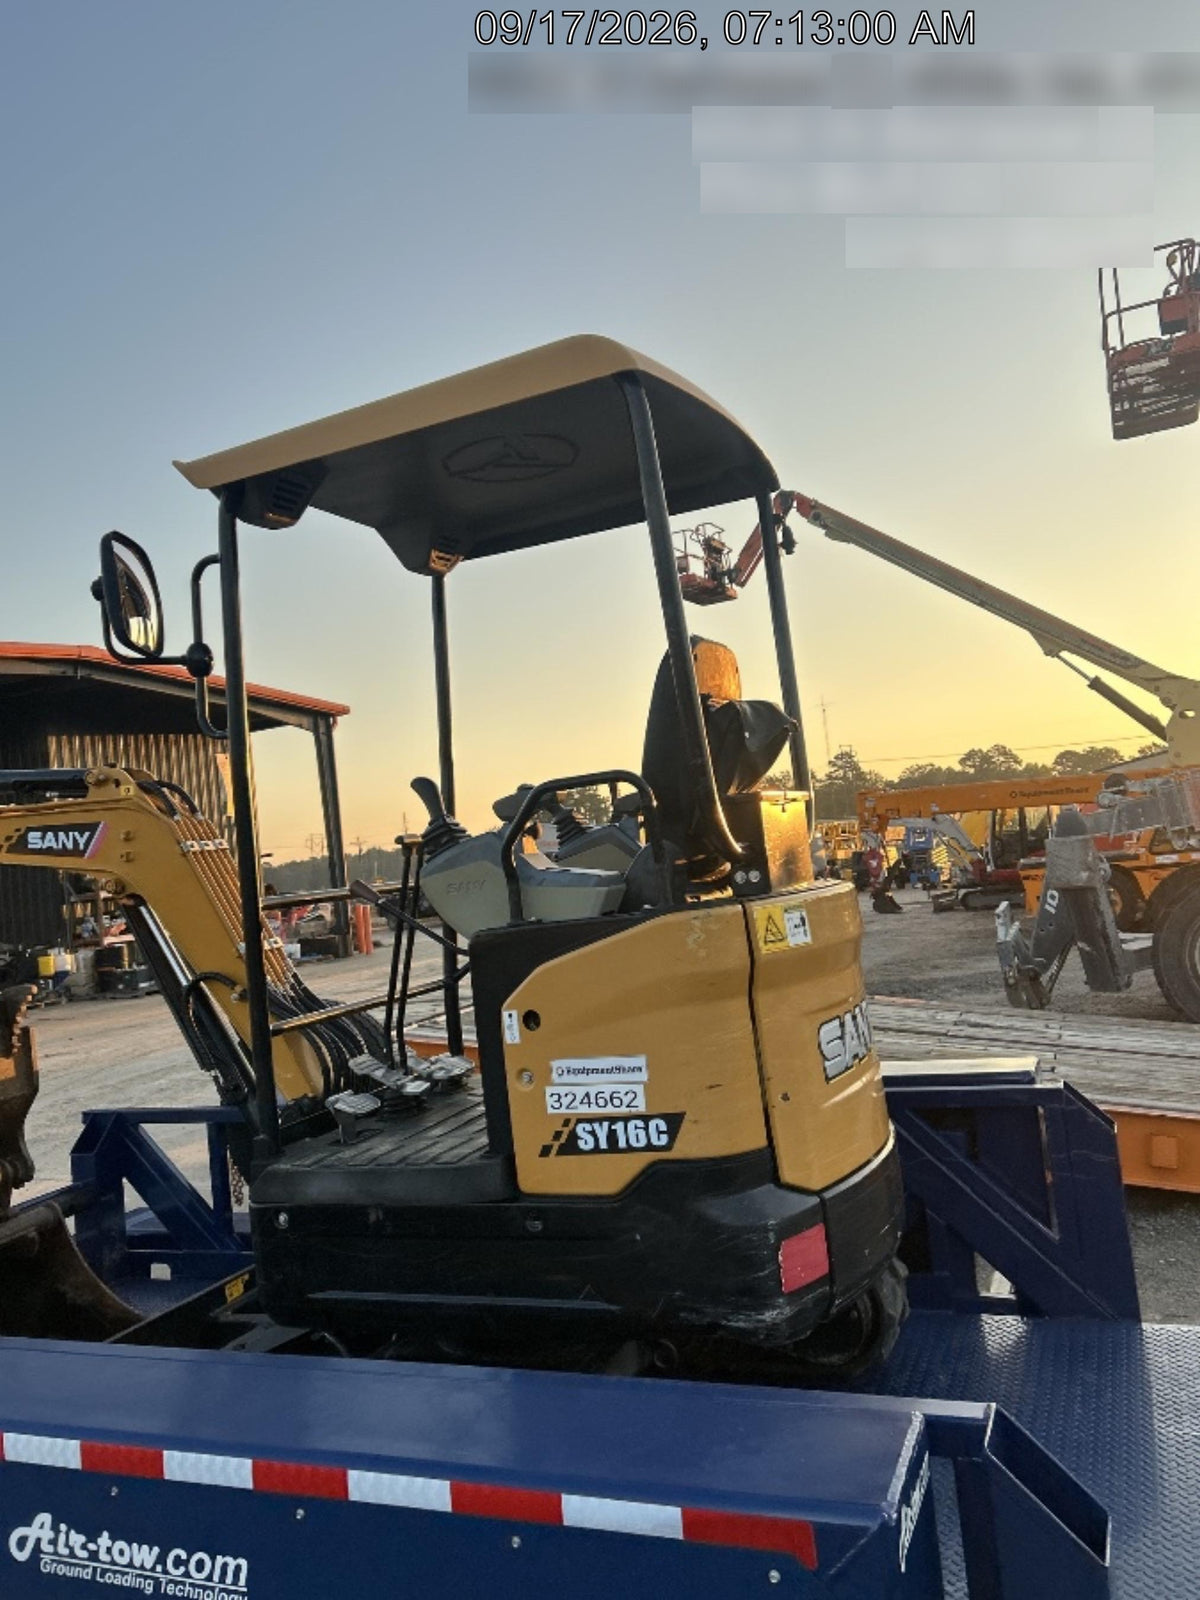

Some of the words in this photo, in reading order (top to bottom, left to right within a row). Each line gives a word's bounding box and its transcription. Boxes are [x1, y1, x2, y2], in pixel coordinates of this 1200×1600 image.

[27, 831, 91, 849] SANY
[818, 1000, 871, 1084] SAN
[549, 1089, 640, 1111] 324662
[575, 1117, 669, 1151] SY16C
[8, 1512, 249, 1587] Air-tow.com
[39, 1557, 92, 1580] Ground
[95, 1566, 154, 1594] Loading
[159, 1578, 248, 1600] Technolo
